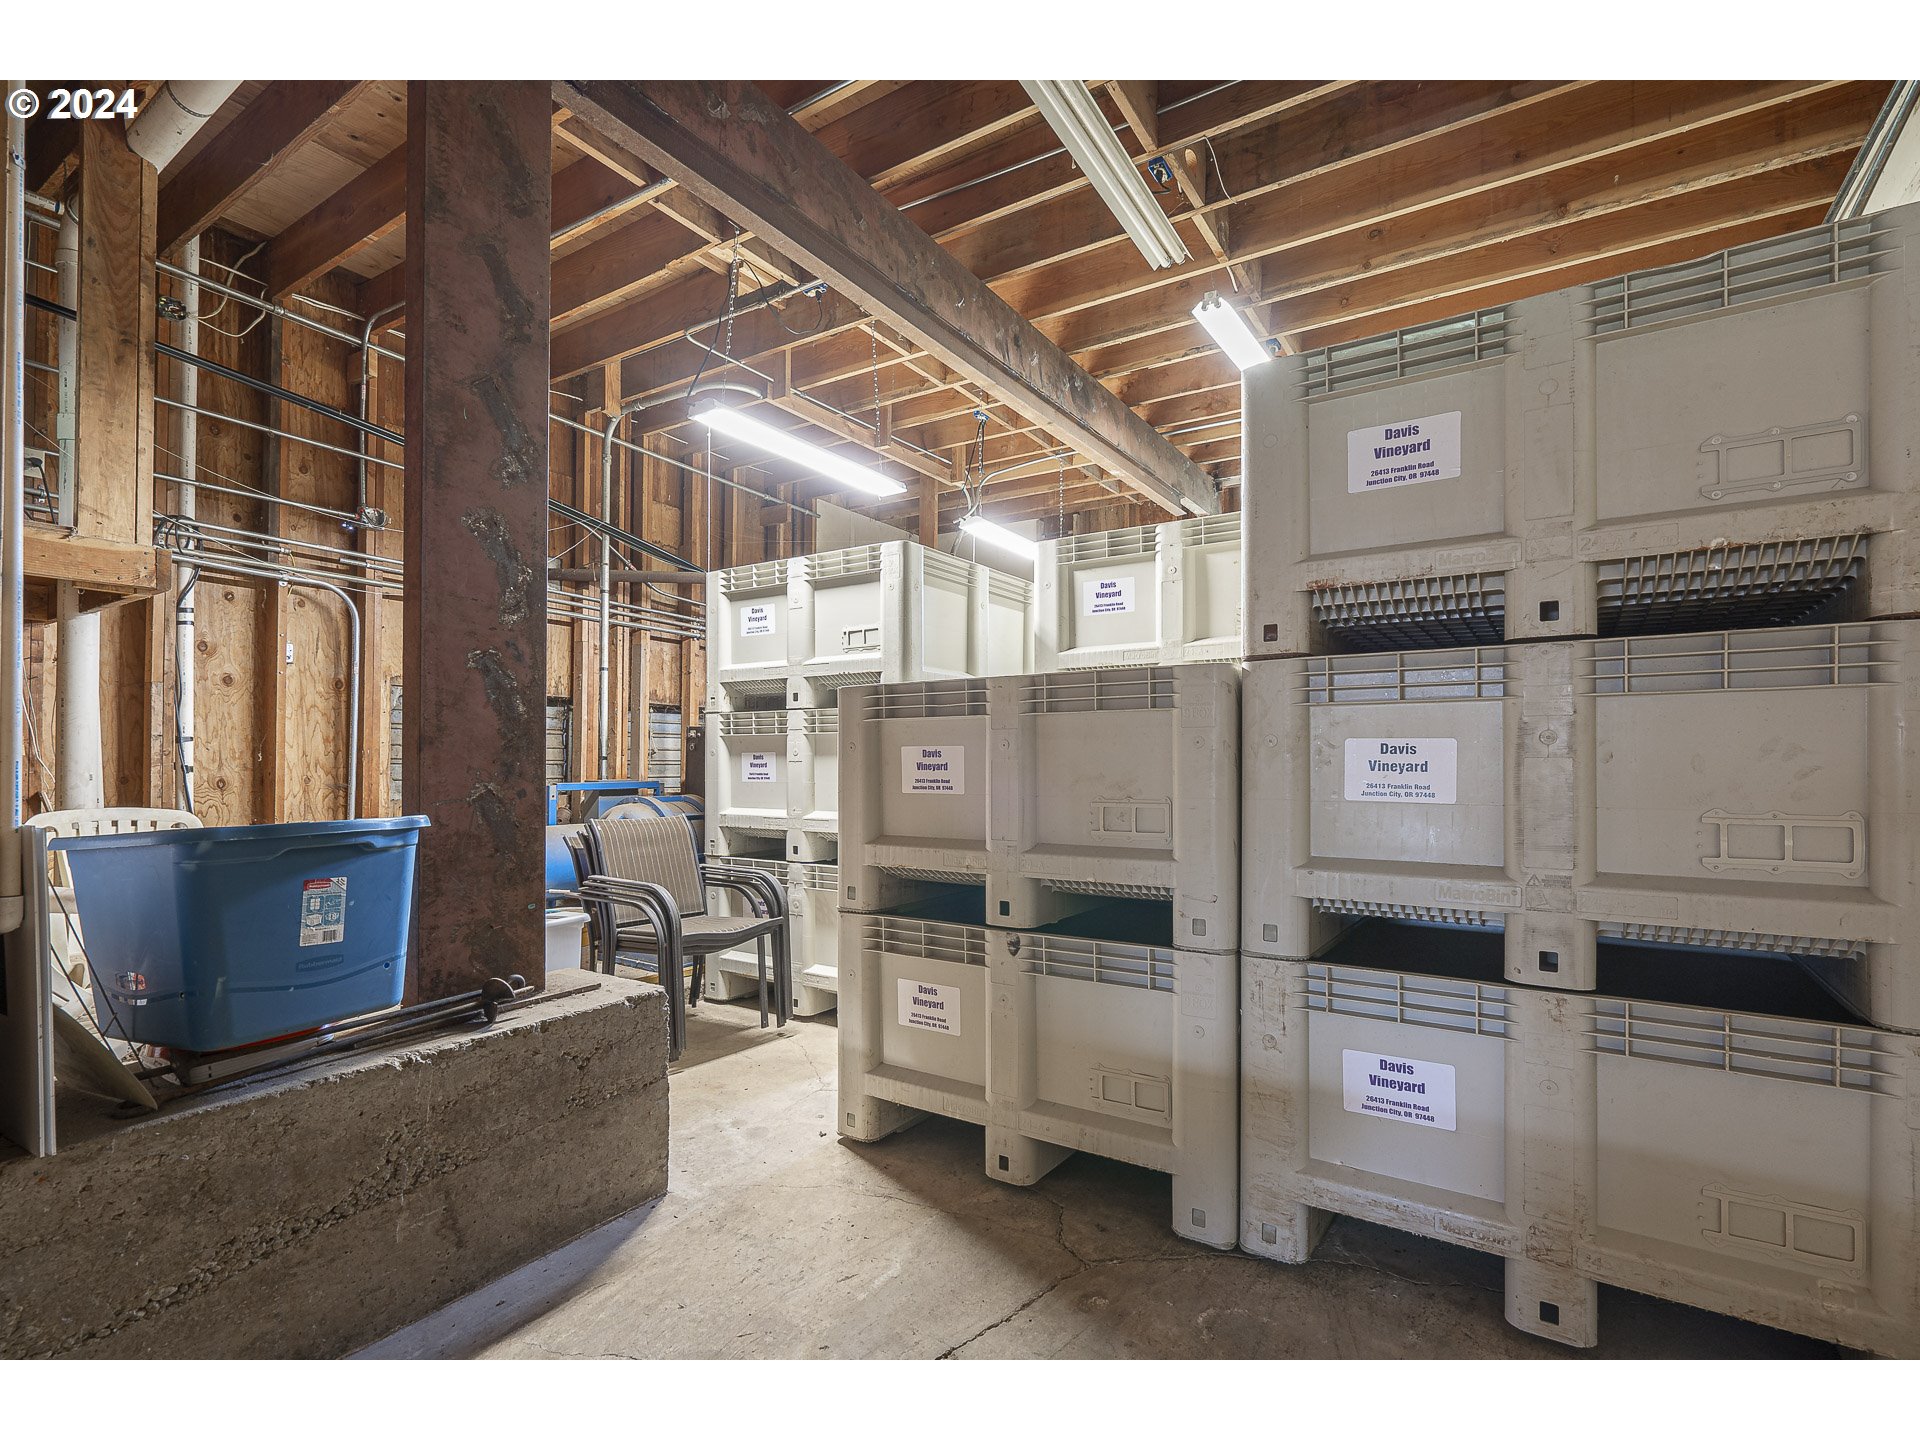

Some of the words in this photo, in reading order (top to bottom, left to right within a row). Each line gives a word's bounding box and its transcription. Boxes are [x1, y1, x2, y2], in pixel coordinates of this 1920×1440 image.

[1384, 424, 1420, 440] Davis
[1373, 439, 1431, 459] Vineyard
[1370, 467, 1390, 477] 26413
[1390, 464, 1417, 474] Franklin
[1417, 461, 1435, 469] Road
[1366, 477, 1393, 486] Junction
[1408, 472, 1418, 480] OR
[1419, 469, 1440, 478] 97448
[1101, 581, 1117, 589] Davis
[1095, 590, 1122, 599] Vineyard
[922, 749, 942, 758] Davis
[1380, 743, 1417, 755] Davis
[916, 762, 948, 771] Vineyard
[1368, 760, 1429, 774] Vineyard
[918, 984, 938, 996] Davis
[912, 996, 944, 1010] Vineyard
[1379, 1058, 1415, 1075] Davis
[1368, 1073, 1426, 1094] Vineyard
[1365, 1095, 1385, 1104] 26413
[1385, 1098, 1412, 1109] Franklin
[1412, 1104, 1430, 1112] Road
[1361, 1102, 1388, 1113] Junction
[1403, 1110, 1413, 1118] OR
[1414, 1113, 1435, 1122] 97448
